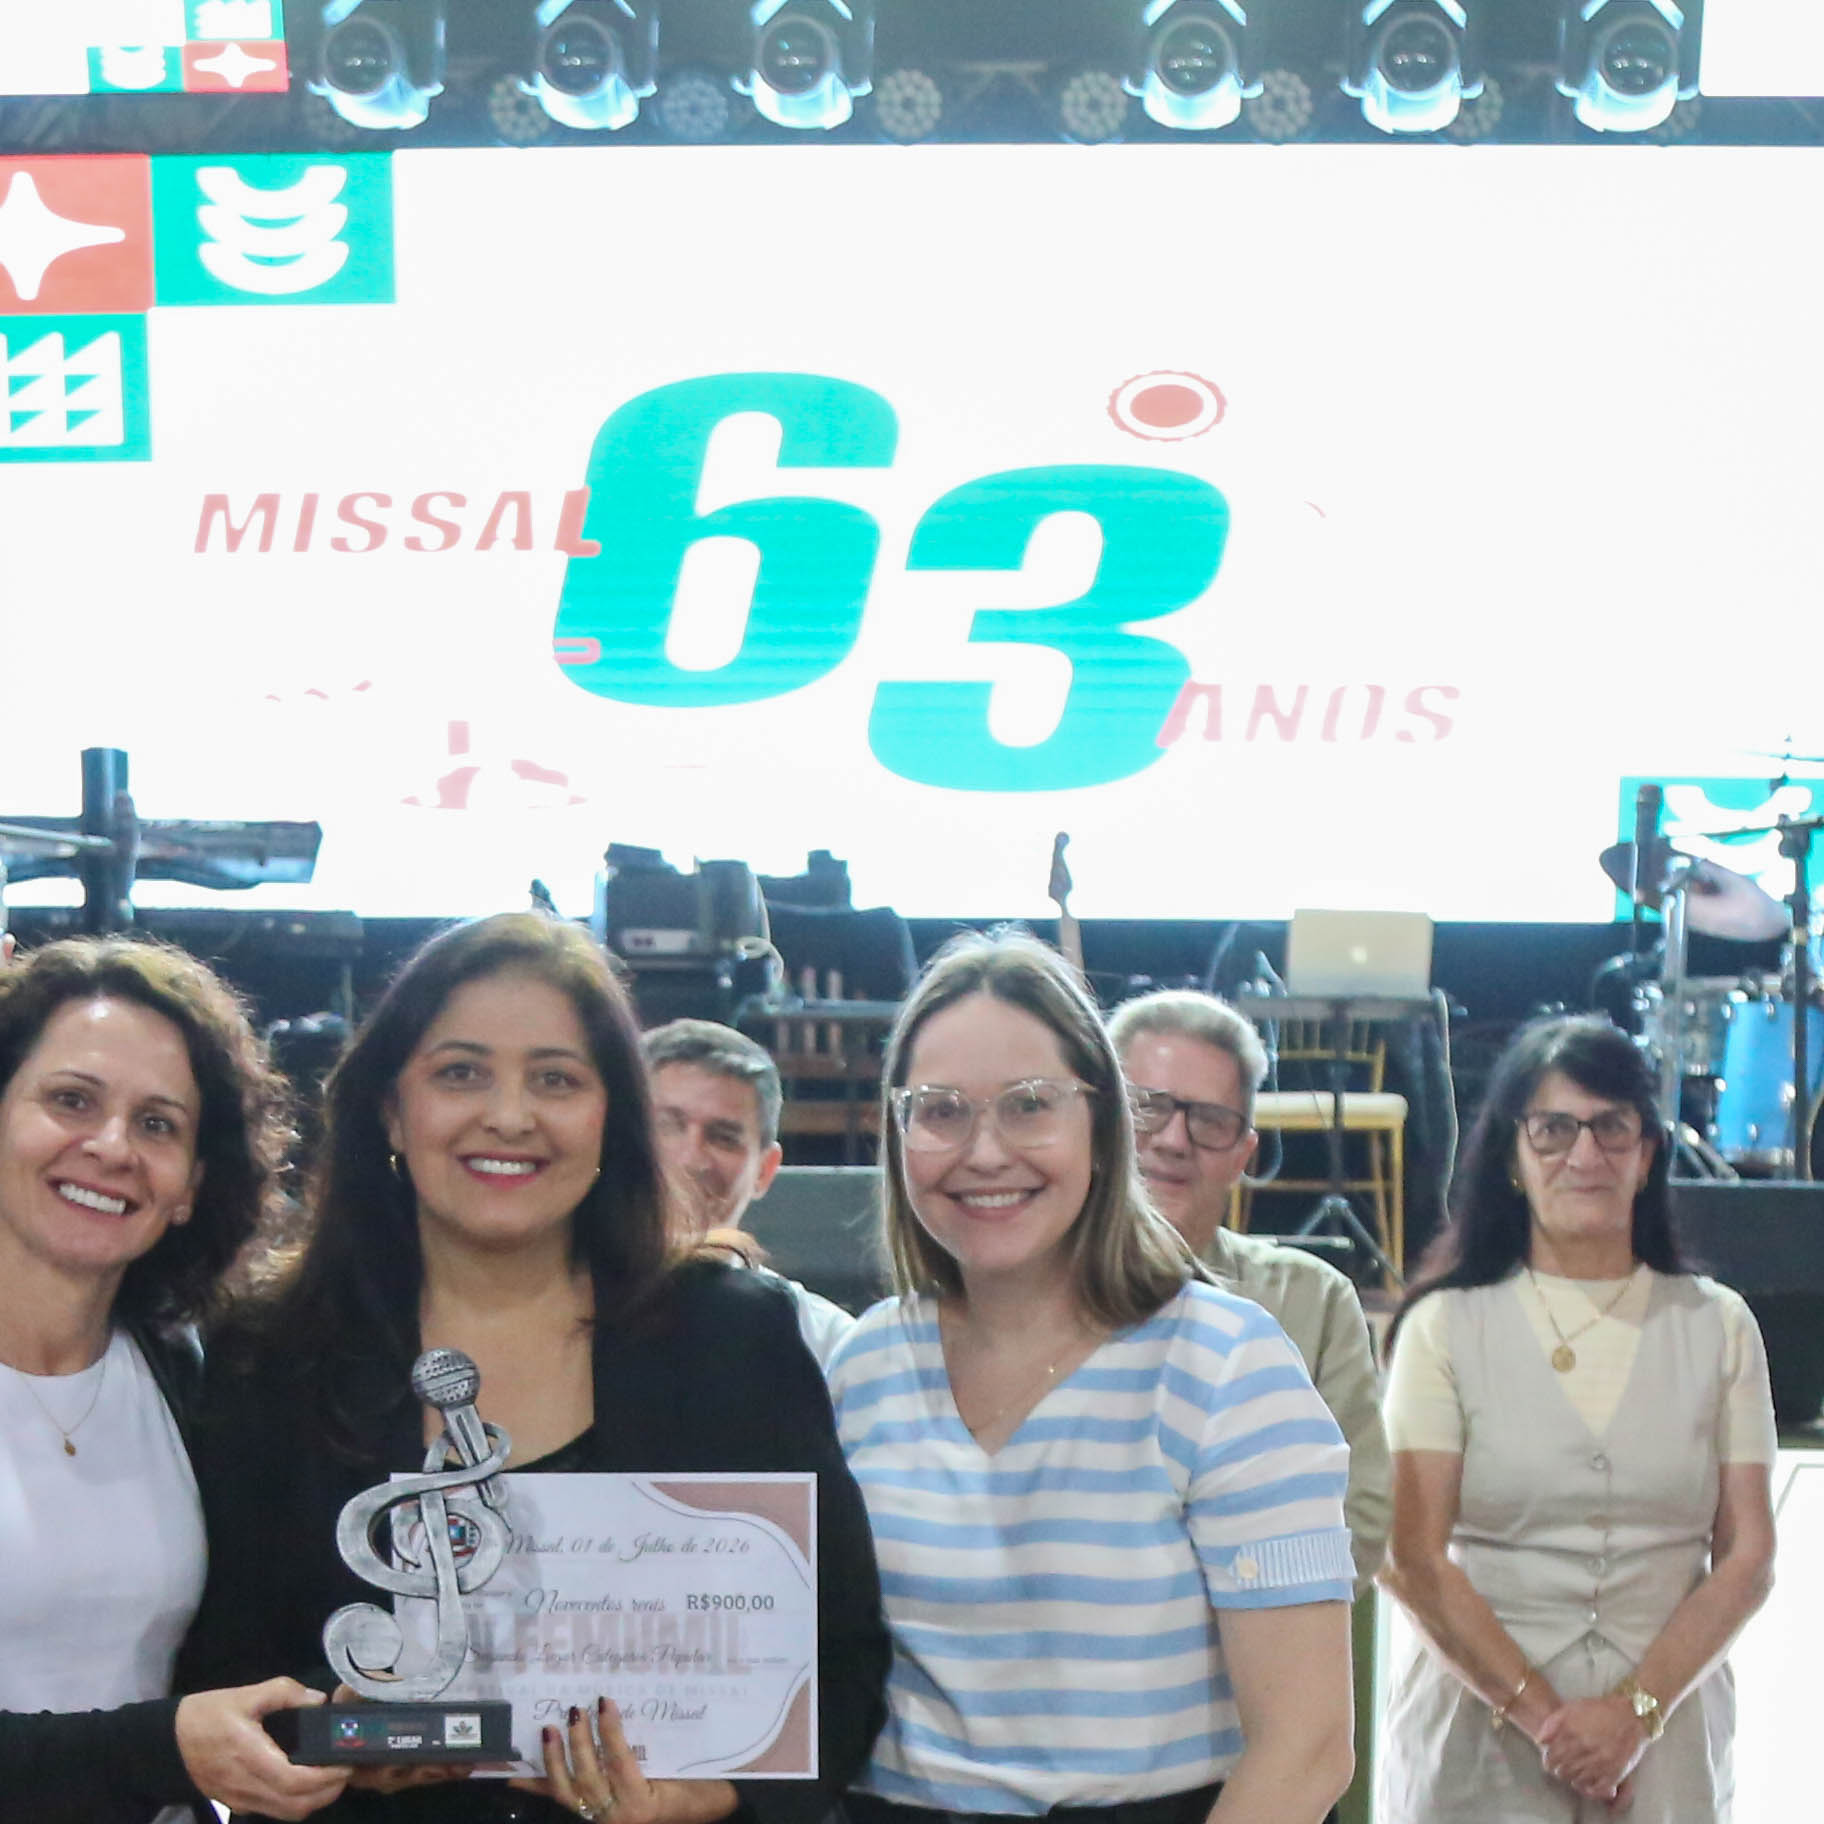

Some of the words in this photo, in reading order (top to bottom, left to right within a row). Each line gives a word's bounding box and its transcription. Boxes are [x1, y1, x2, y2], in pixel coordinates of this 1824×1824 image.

[194, 485, 601, 557] MISSAL
[554, 371, 1231, 792] 63
[1157, 680, 1459, 748] ANOS
[687, 1593, 775, 1612] R$900,00
